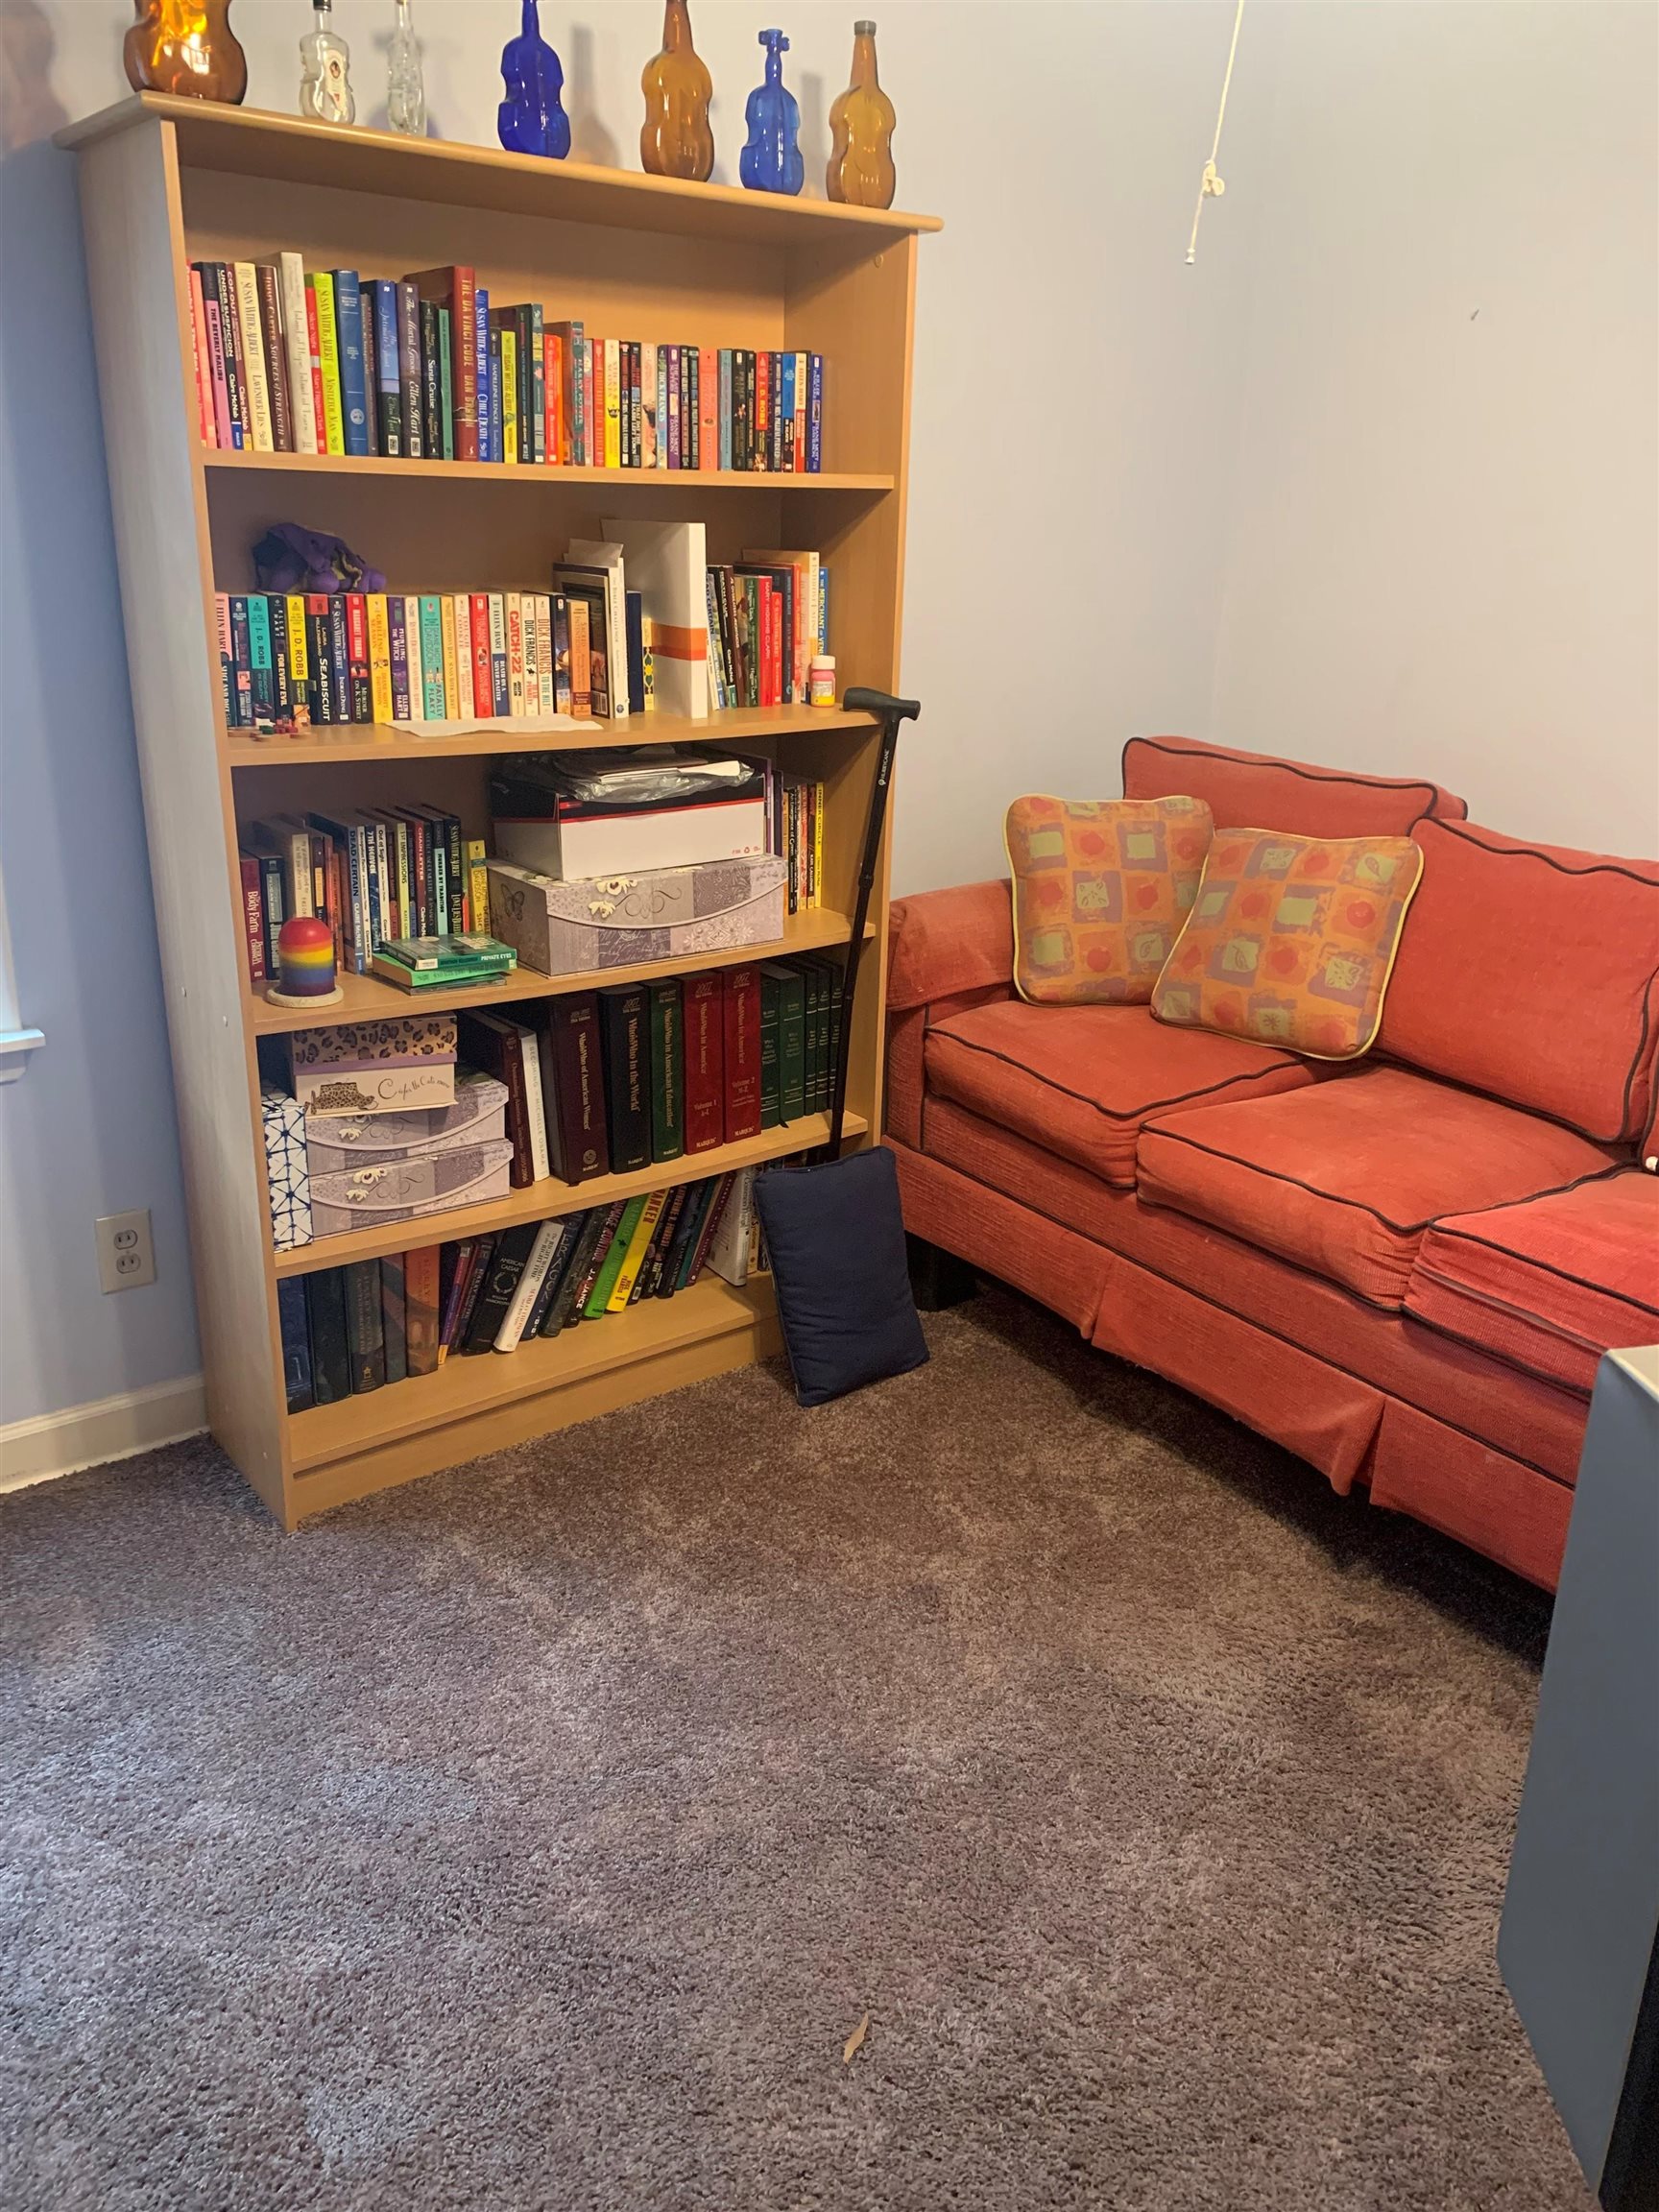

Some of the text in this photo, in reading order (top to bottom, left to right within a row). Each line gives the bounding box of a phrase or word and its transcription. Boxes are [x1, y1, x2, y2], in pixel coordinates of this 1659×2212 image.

[220, 270, 229, 301] UNDER
[225, 304, 234, 358] SUSPICION
[320, 290, 330, 313] SUSAN
[212, 324, 221, 352] BEVERLY
[322, 337, 334, 362] ALBERT
[241, 281, 267, 428] SUSAN ALBERT LAVENDER LIES
[271, 344, 282, 384] SOURCES
[294, 310, 309, 396] Island Hope Island
[406, 297, 421, 434] The Mortal Groove Ellen Hart
[462, 278, 474, 428] THE DA VINCI CODE DAN BROWN
[215, 355, 224, 381] MALIBU
[475, 307, 488, 440] SUSAN ALBERT CHILE DEATH
[759, 390, 766, 398] D.
[241, 407, 250, 430] McNab
[275, 392, 284, 435] STRENGTH
[328, 417, 338, 432] MAN
[388, 397, 400, 432] Ellen Hart
[332, 611, 341, 630] SUSAN
[538, 618, 549, 637] DICK
[707, 600, 715, 635] CERTAIN
[257, 636, 265, 644] D.
[295, 637, 303, 647] D.
[393, 639, 401, 661] WITCH
[524, 620, 536, 666] DICK FRANCIS
[296, 649, 304, 676] ROBB
[335, 649, 344, 670] ALBERT
[538, 639, 551, 675] FRANCIS
[320, 658, 330, 722] SEABISCUIT
[355, 680, 359, 689] ON
[542, 694, 551, 707] HILT
[449, 825, 461, 919] SUSAN ALBERT LOVE LIES
[246, 891, 260, 933] Body Farm
[250, 939, 259, 966] CORNWELL
[528, 1046, 538, 1088] BECOMING
[665, 1053, 674, 1089] American
[630, 1071, 640, 1111] the World
[732, 1079, 750, 1090] Volume
[693, 1101, 712, 1111] Volume
[696, 1138, 714, 1147] MARQUIS
[734, 1126, 752, 1137] MARQUIS
[591, 1227, 613, 1262] CONTROL
[499, 1258, 525, 1267] AMERICAN
[500, 1263, 520, 1273] CAESAR
[530, 1244, 547, 1280] RIGHT TIME
[536, 1240, 555, 1283] RIGHT WORDS
[576, 1283, 590, 1310] JANCE
[616, 1275, 628, 1294] FRANCIS
[624, 1279, 633, 1290] DICK
[514, 1288, 537, 1338] MARLO THOMAS
